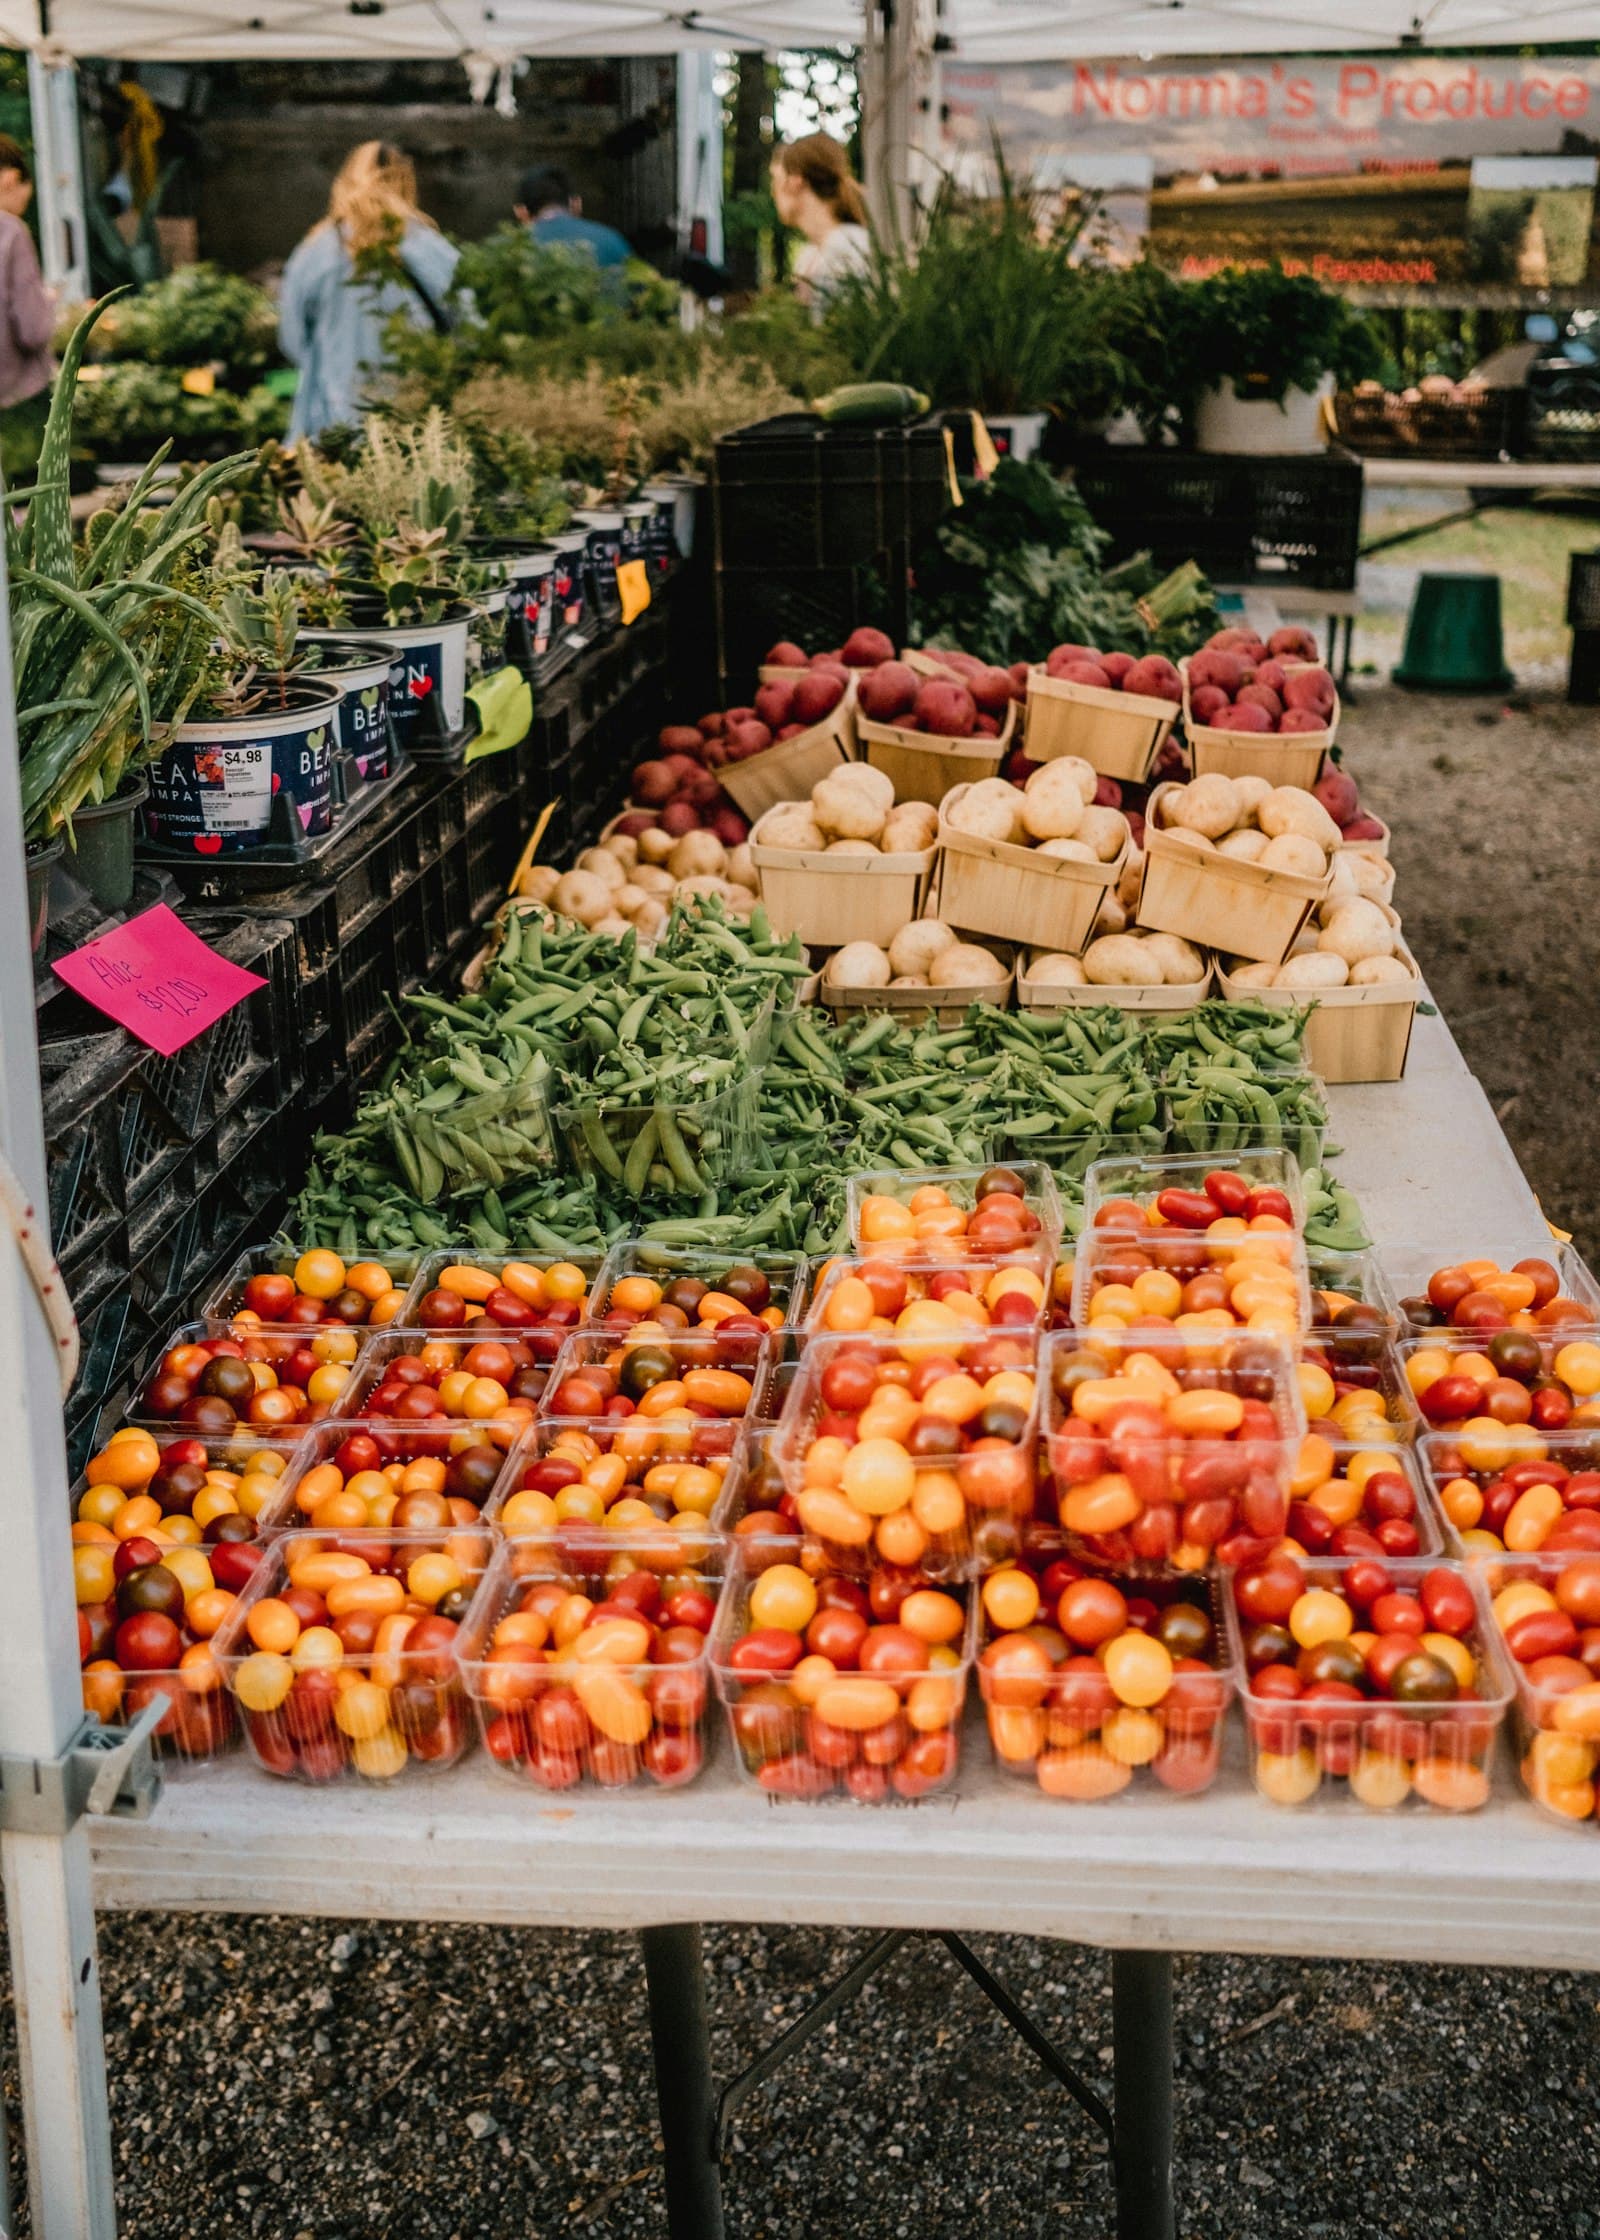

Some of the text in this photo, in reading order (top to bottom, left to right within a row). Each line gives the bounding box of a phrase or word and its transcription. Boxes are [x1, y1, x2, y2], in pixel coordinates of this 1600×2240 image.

[1072, 62, 1590, 119] Norma's Produce
[1312, 254, 1436, 283] Facebook
[353, 701, 386, 731] BEA
[224, 750, 263, 766] $4.98
[300, 743, 331, 775] BEA
[151, 788, 199, 802] IMPA
[167, 812, 205, 823] STRONGE
